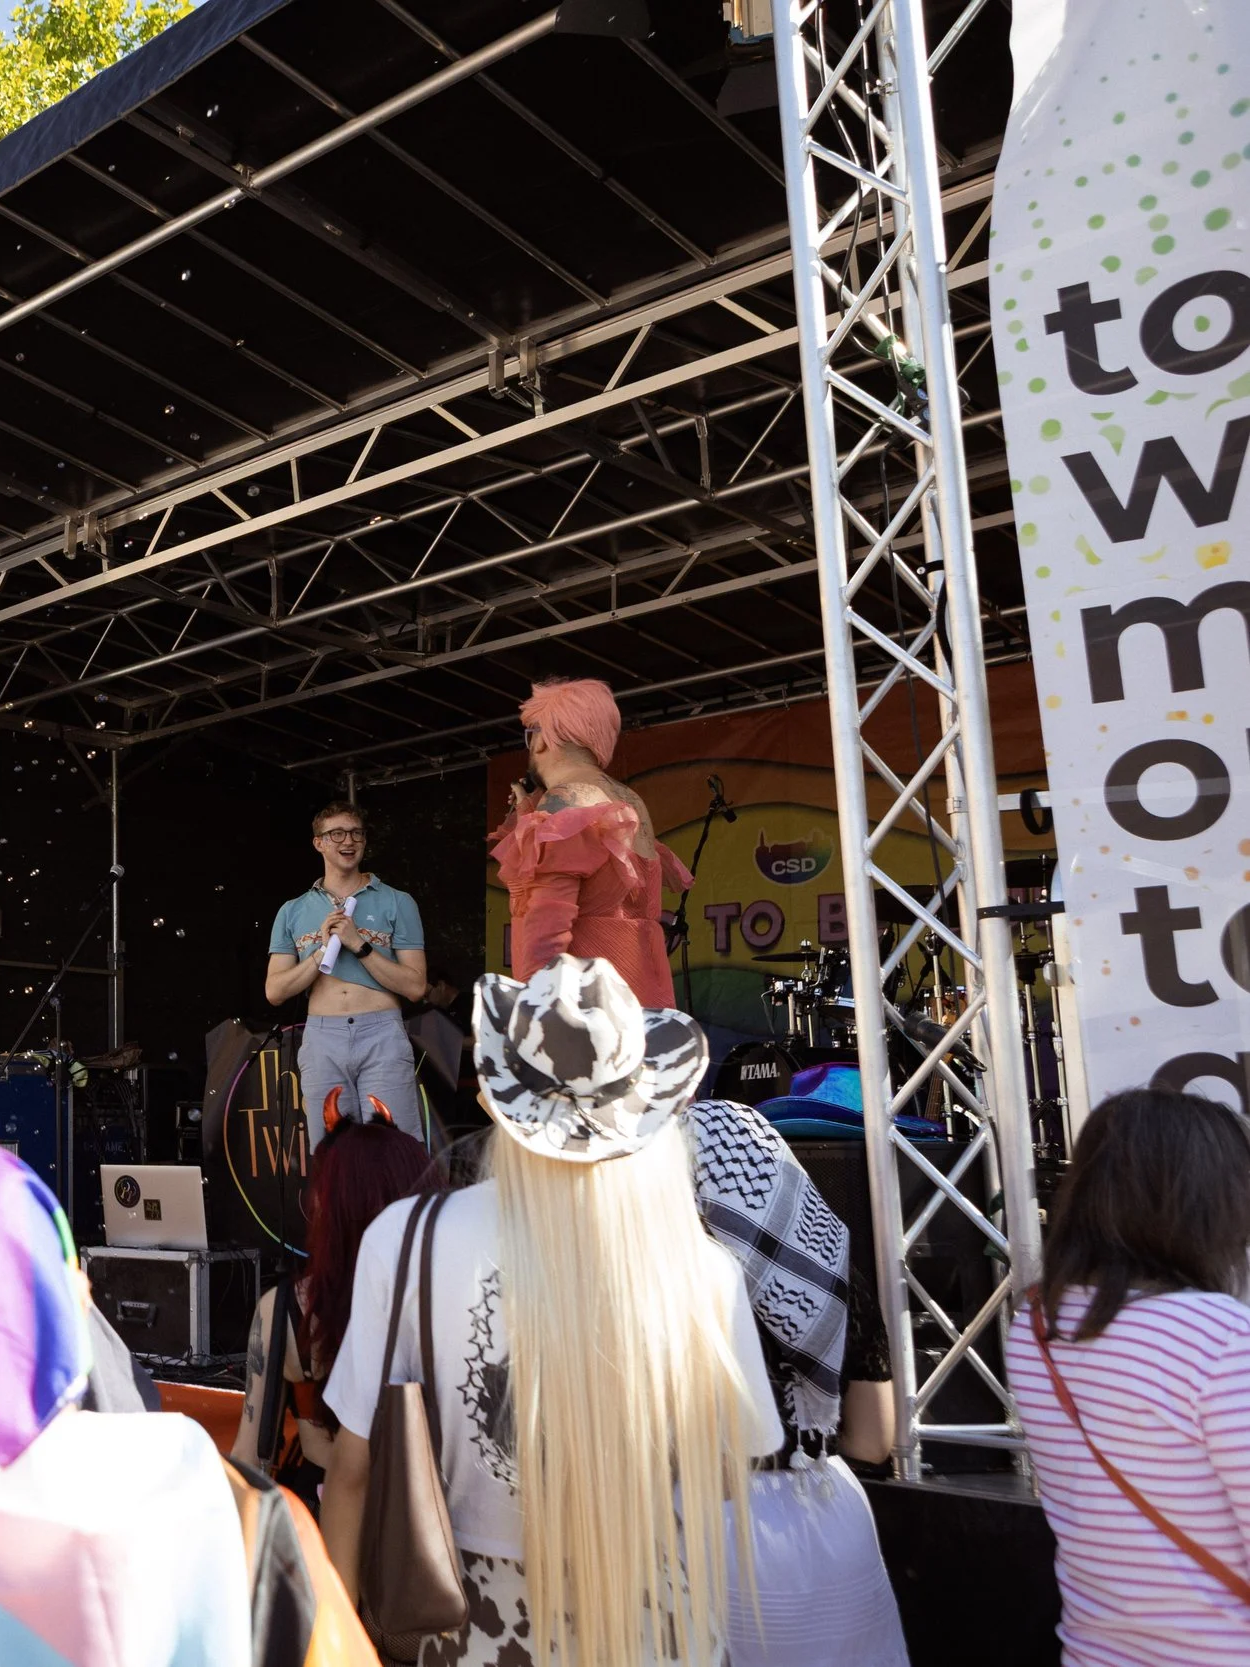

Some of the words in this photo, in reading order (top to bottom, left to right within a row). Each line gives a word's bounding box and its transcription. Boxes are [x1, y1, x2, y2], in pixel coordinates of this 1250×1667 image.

[771, 857, 817, 876] CSD
[704, 900, 785, 952] TO
[1119, 885, 1250, 1008] t
[747, 1062, 778, 1080] TAMA
